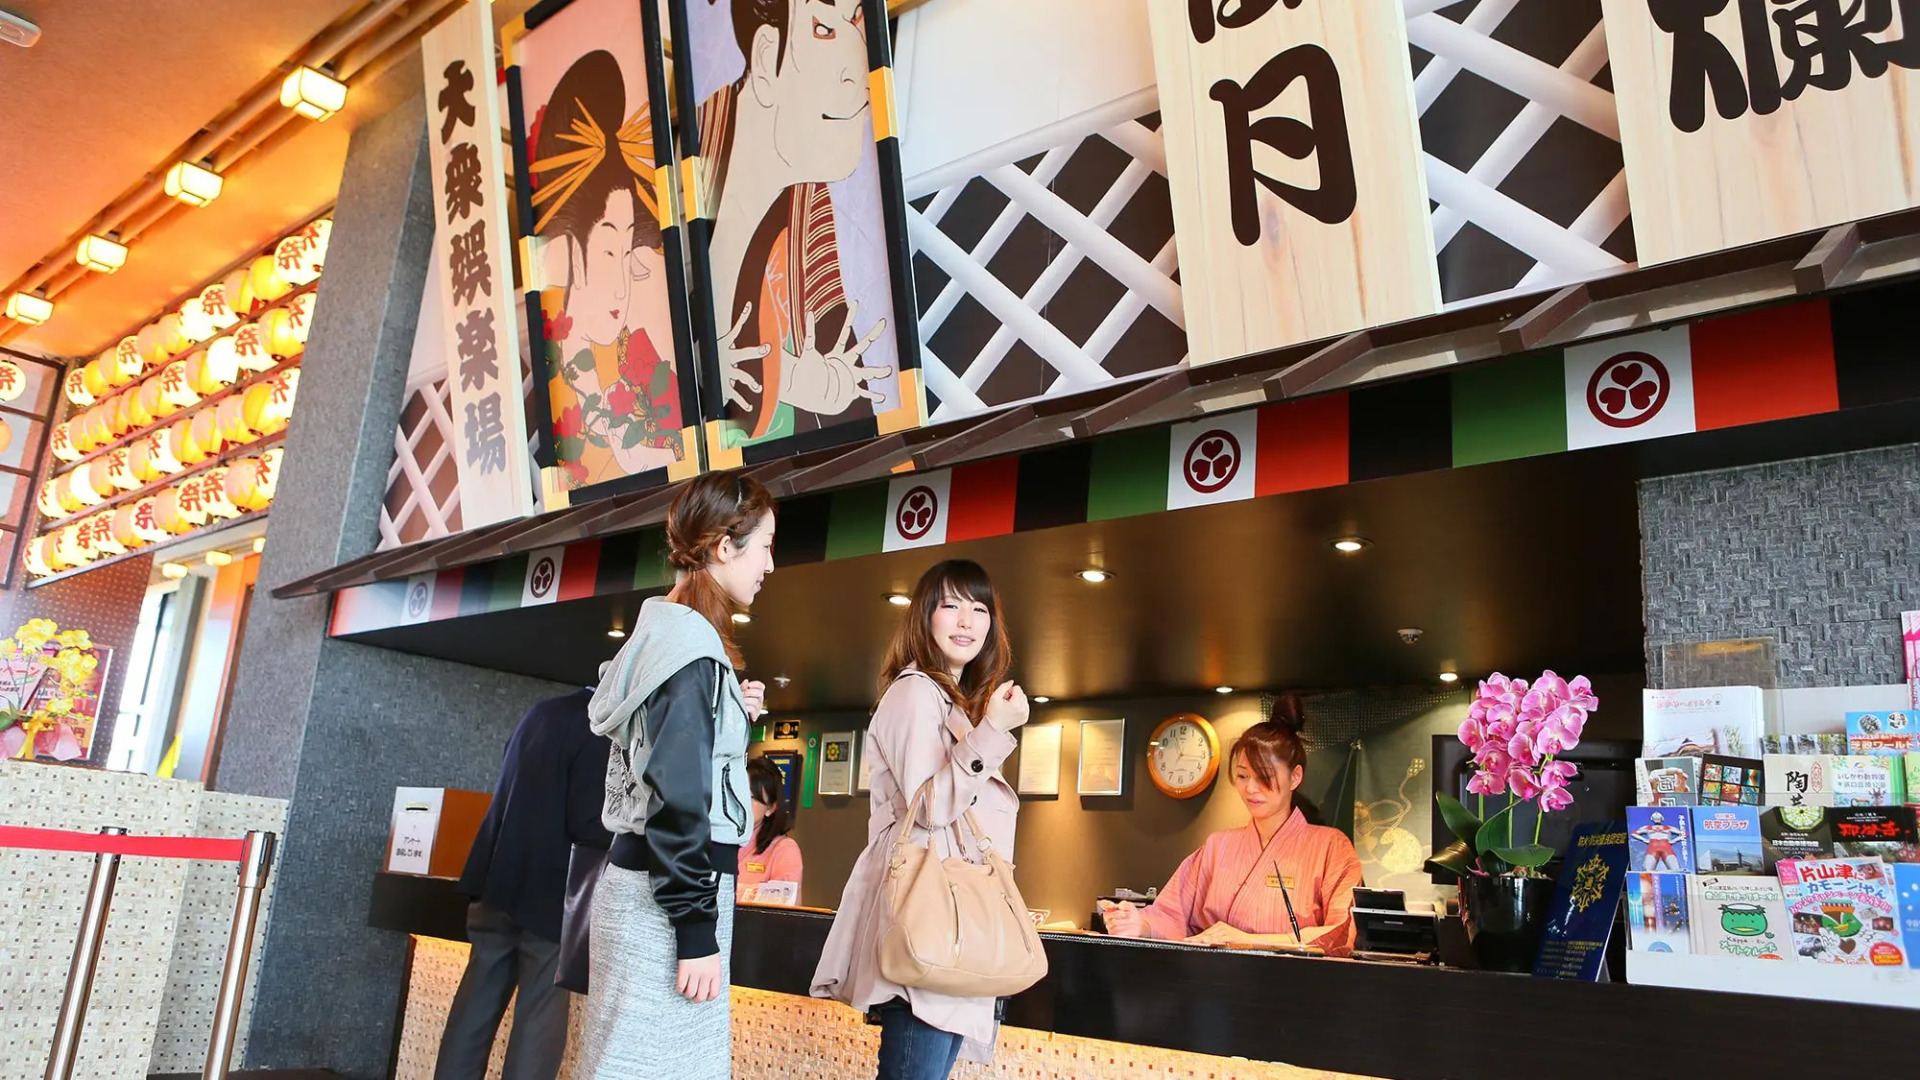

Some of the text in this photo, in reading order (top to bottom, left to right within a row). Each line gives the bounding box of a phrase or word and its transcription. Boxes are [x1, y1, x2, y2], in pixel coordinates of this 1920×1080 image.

[1187, 0, 1358, 247] 月
[278, 241, 302, 270] 祭
[438, 59, 507, 477] 大衆娯楽場
[202, 288, 225, 316] 祭
[235, 328, 259, 357] 祭
[179, 480, 202, 512] 祭
[135, 502, 158, 530] 祭
